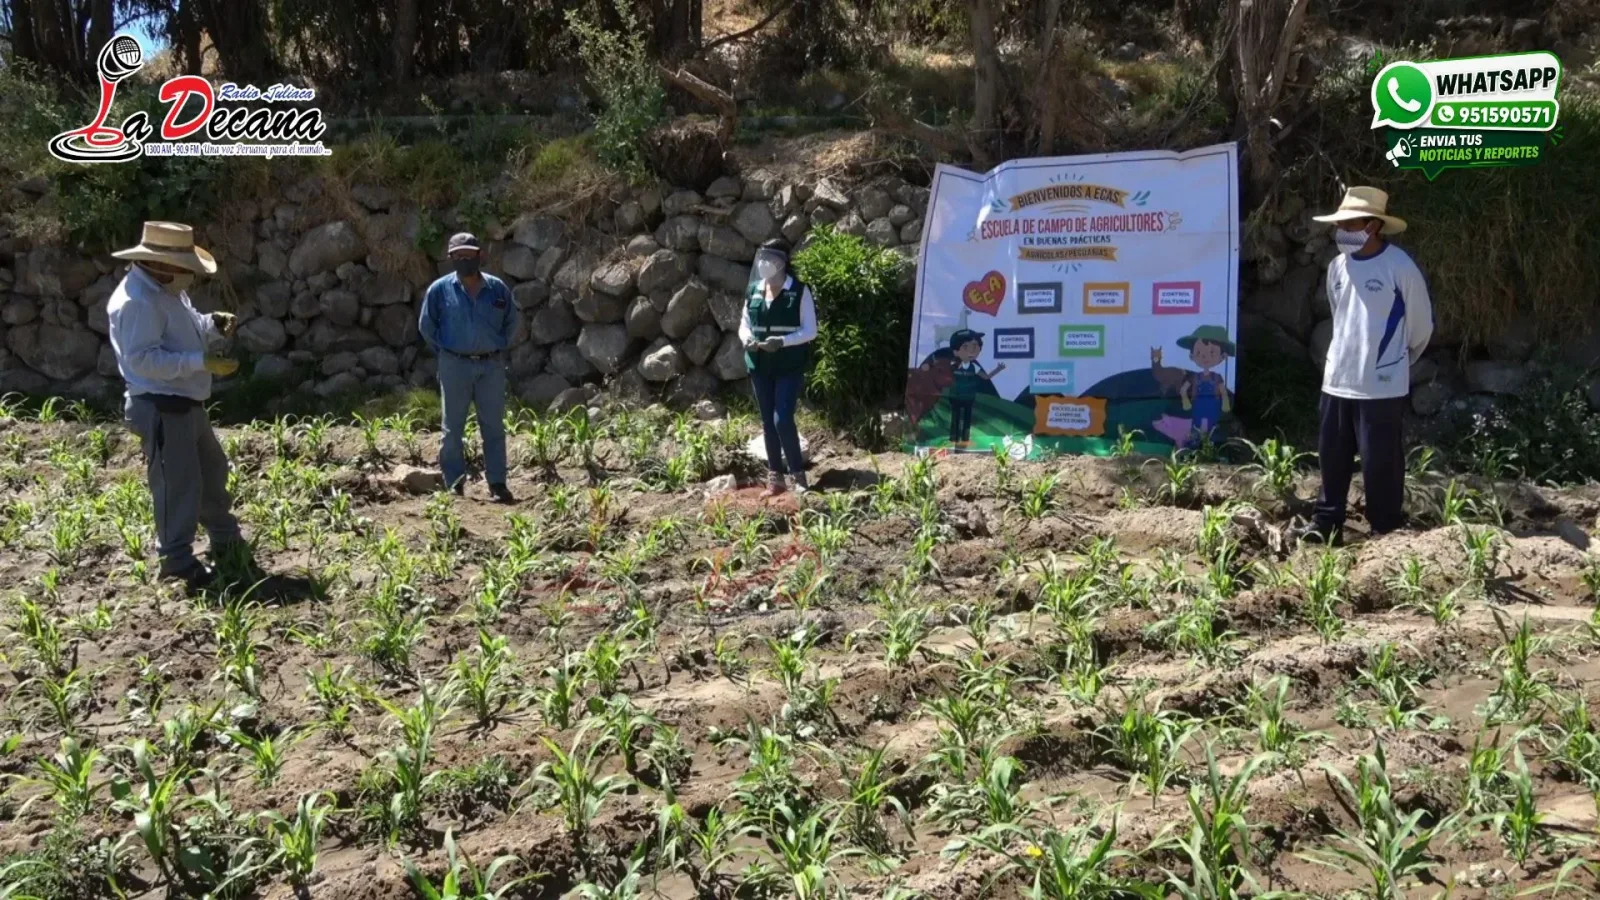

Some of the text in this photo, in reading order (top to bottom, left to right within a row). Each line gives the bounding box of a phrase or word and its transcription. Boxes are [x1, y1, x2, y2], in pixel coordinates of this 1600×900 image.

[1018, 185, 1121, 208] BIENVENIDOS A ECAS
[981, 211, 1164, 240] ESCUELA DE CAMPO DE AGRICULTORES
[1023, 237, 1035, 246] EN
[1036, 236, 1067, 246] BUENAS
[968, 275, 1001, 306] ECA
